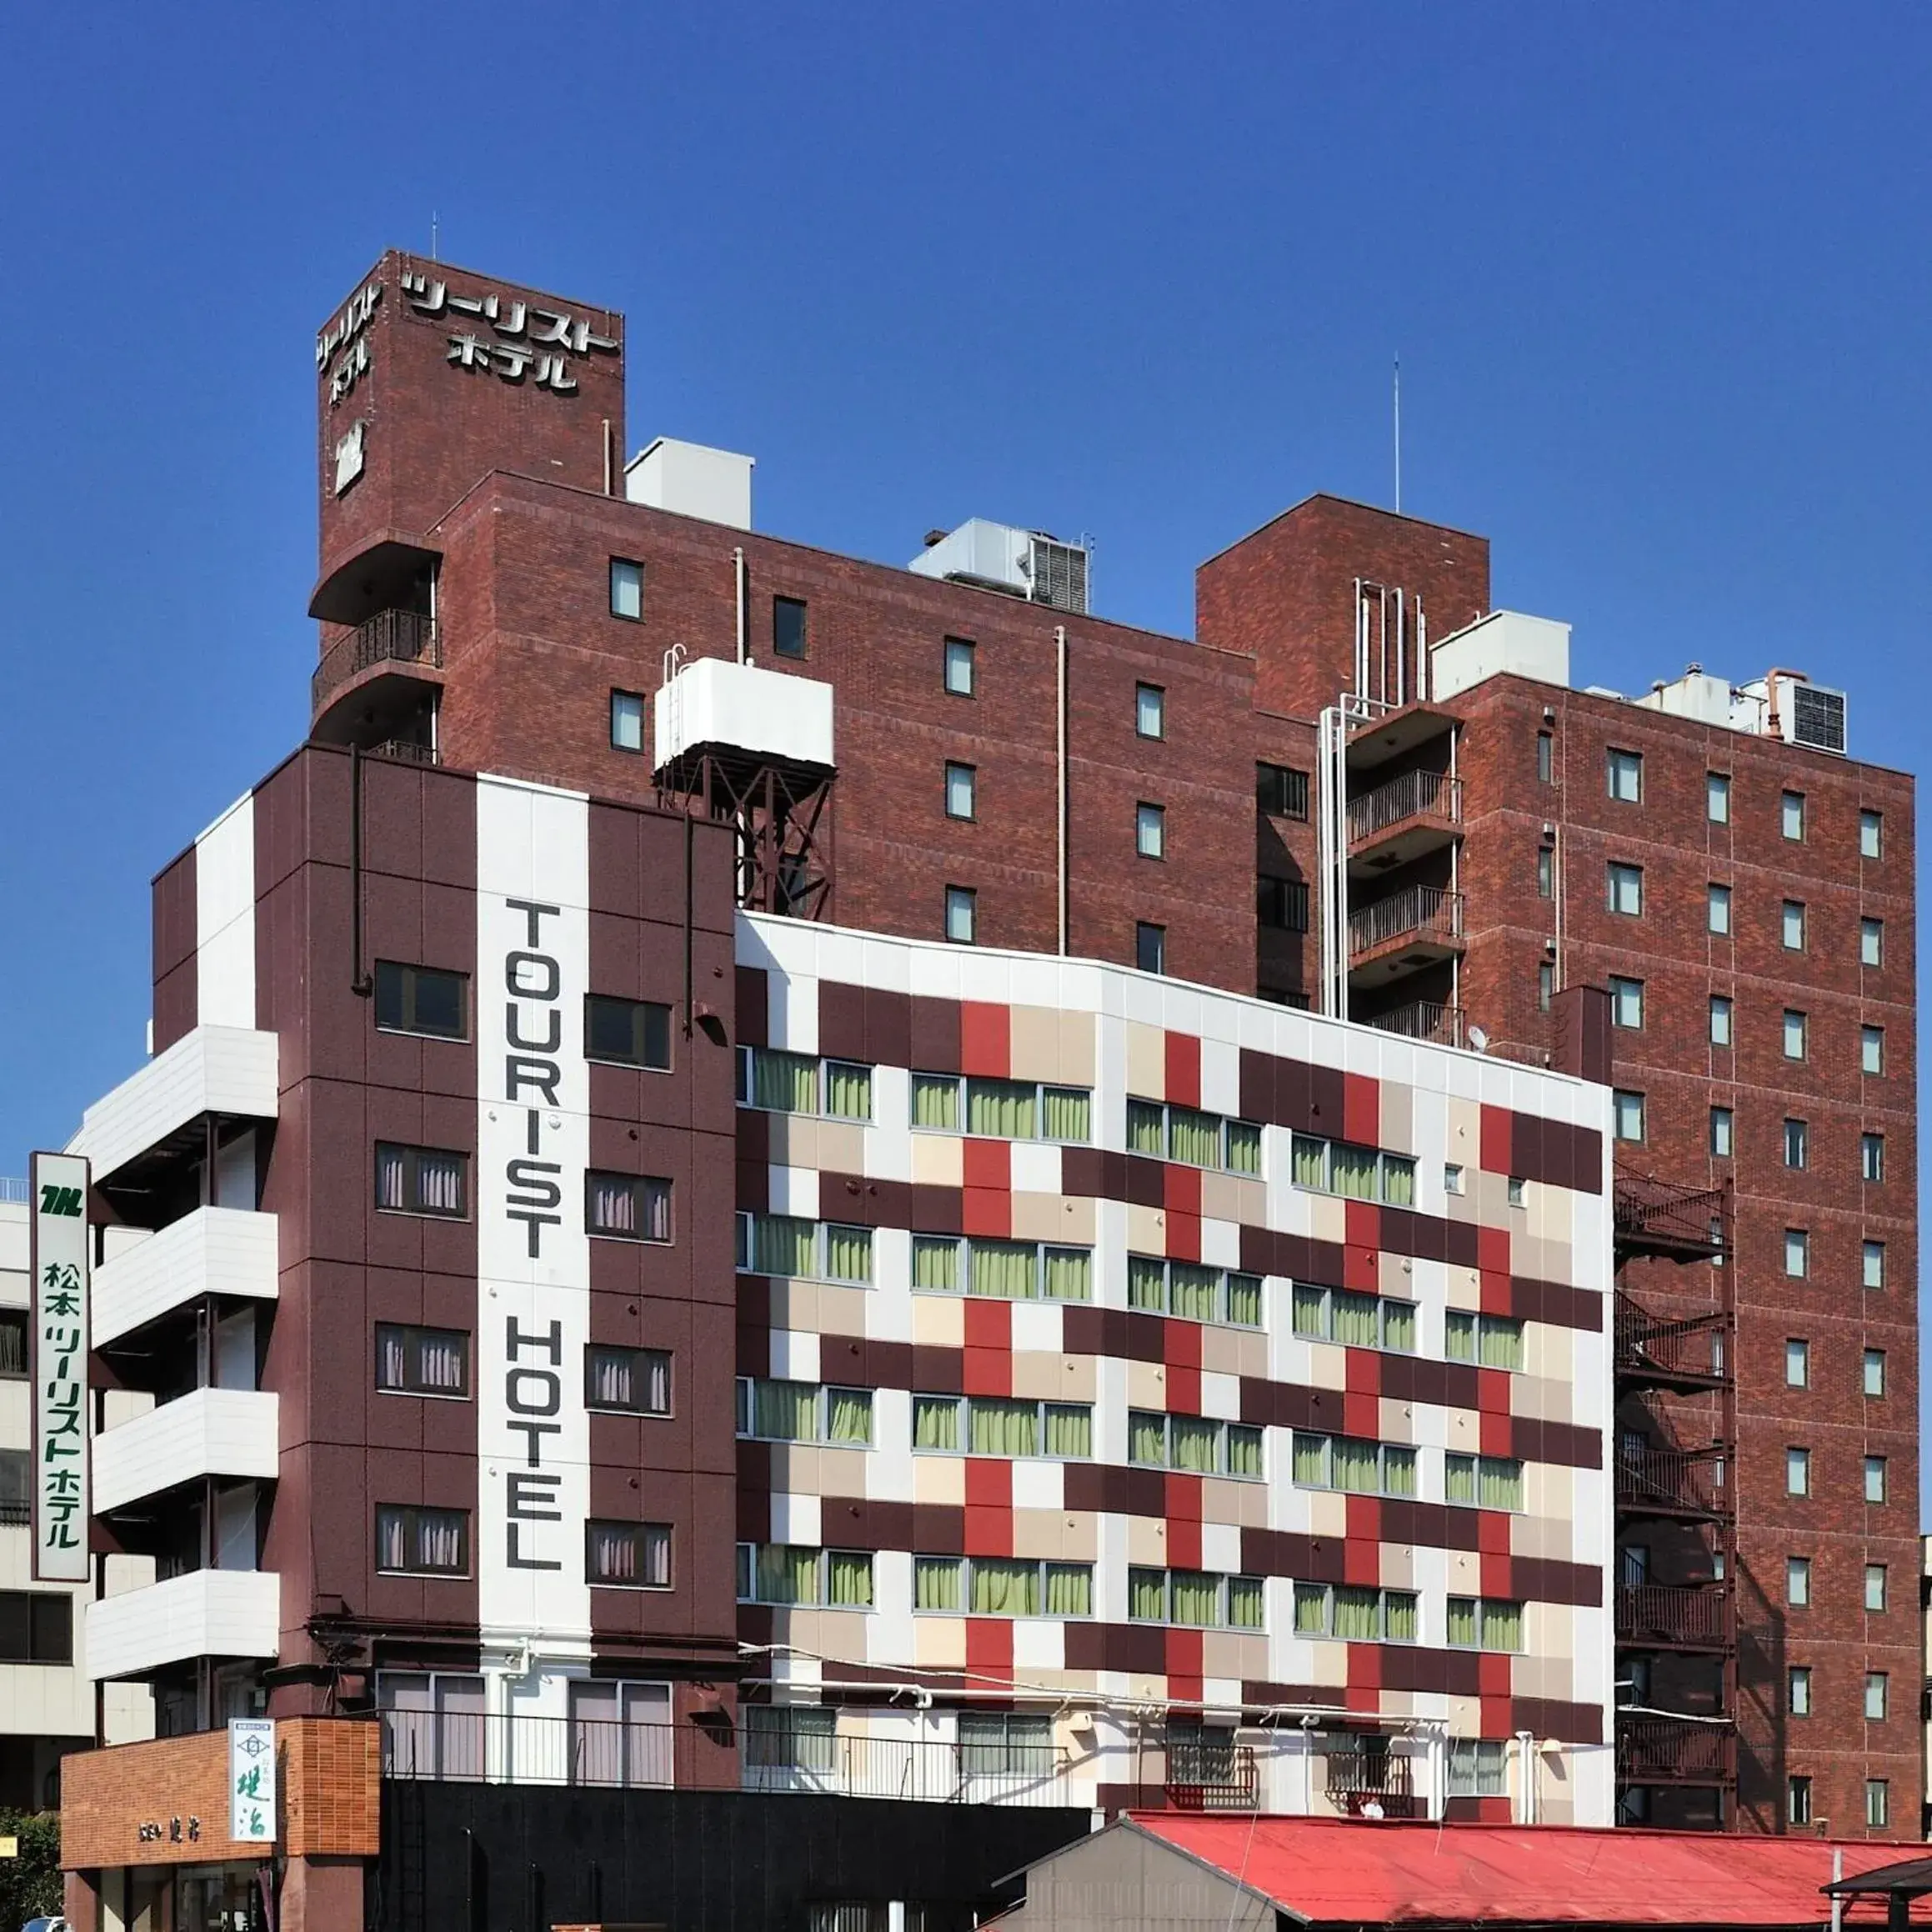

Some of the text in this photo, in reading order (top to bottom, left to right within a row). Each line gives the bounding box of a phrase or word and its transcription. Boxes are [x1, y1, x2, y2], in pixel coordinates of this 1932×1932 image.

[401, 270, 618, 353] ツーリスト
[447, 333, 577, 389] ホテル
[505, 898, 563, 1571] TOURIST HOTEL
